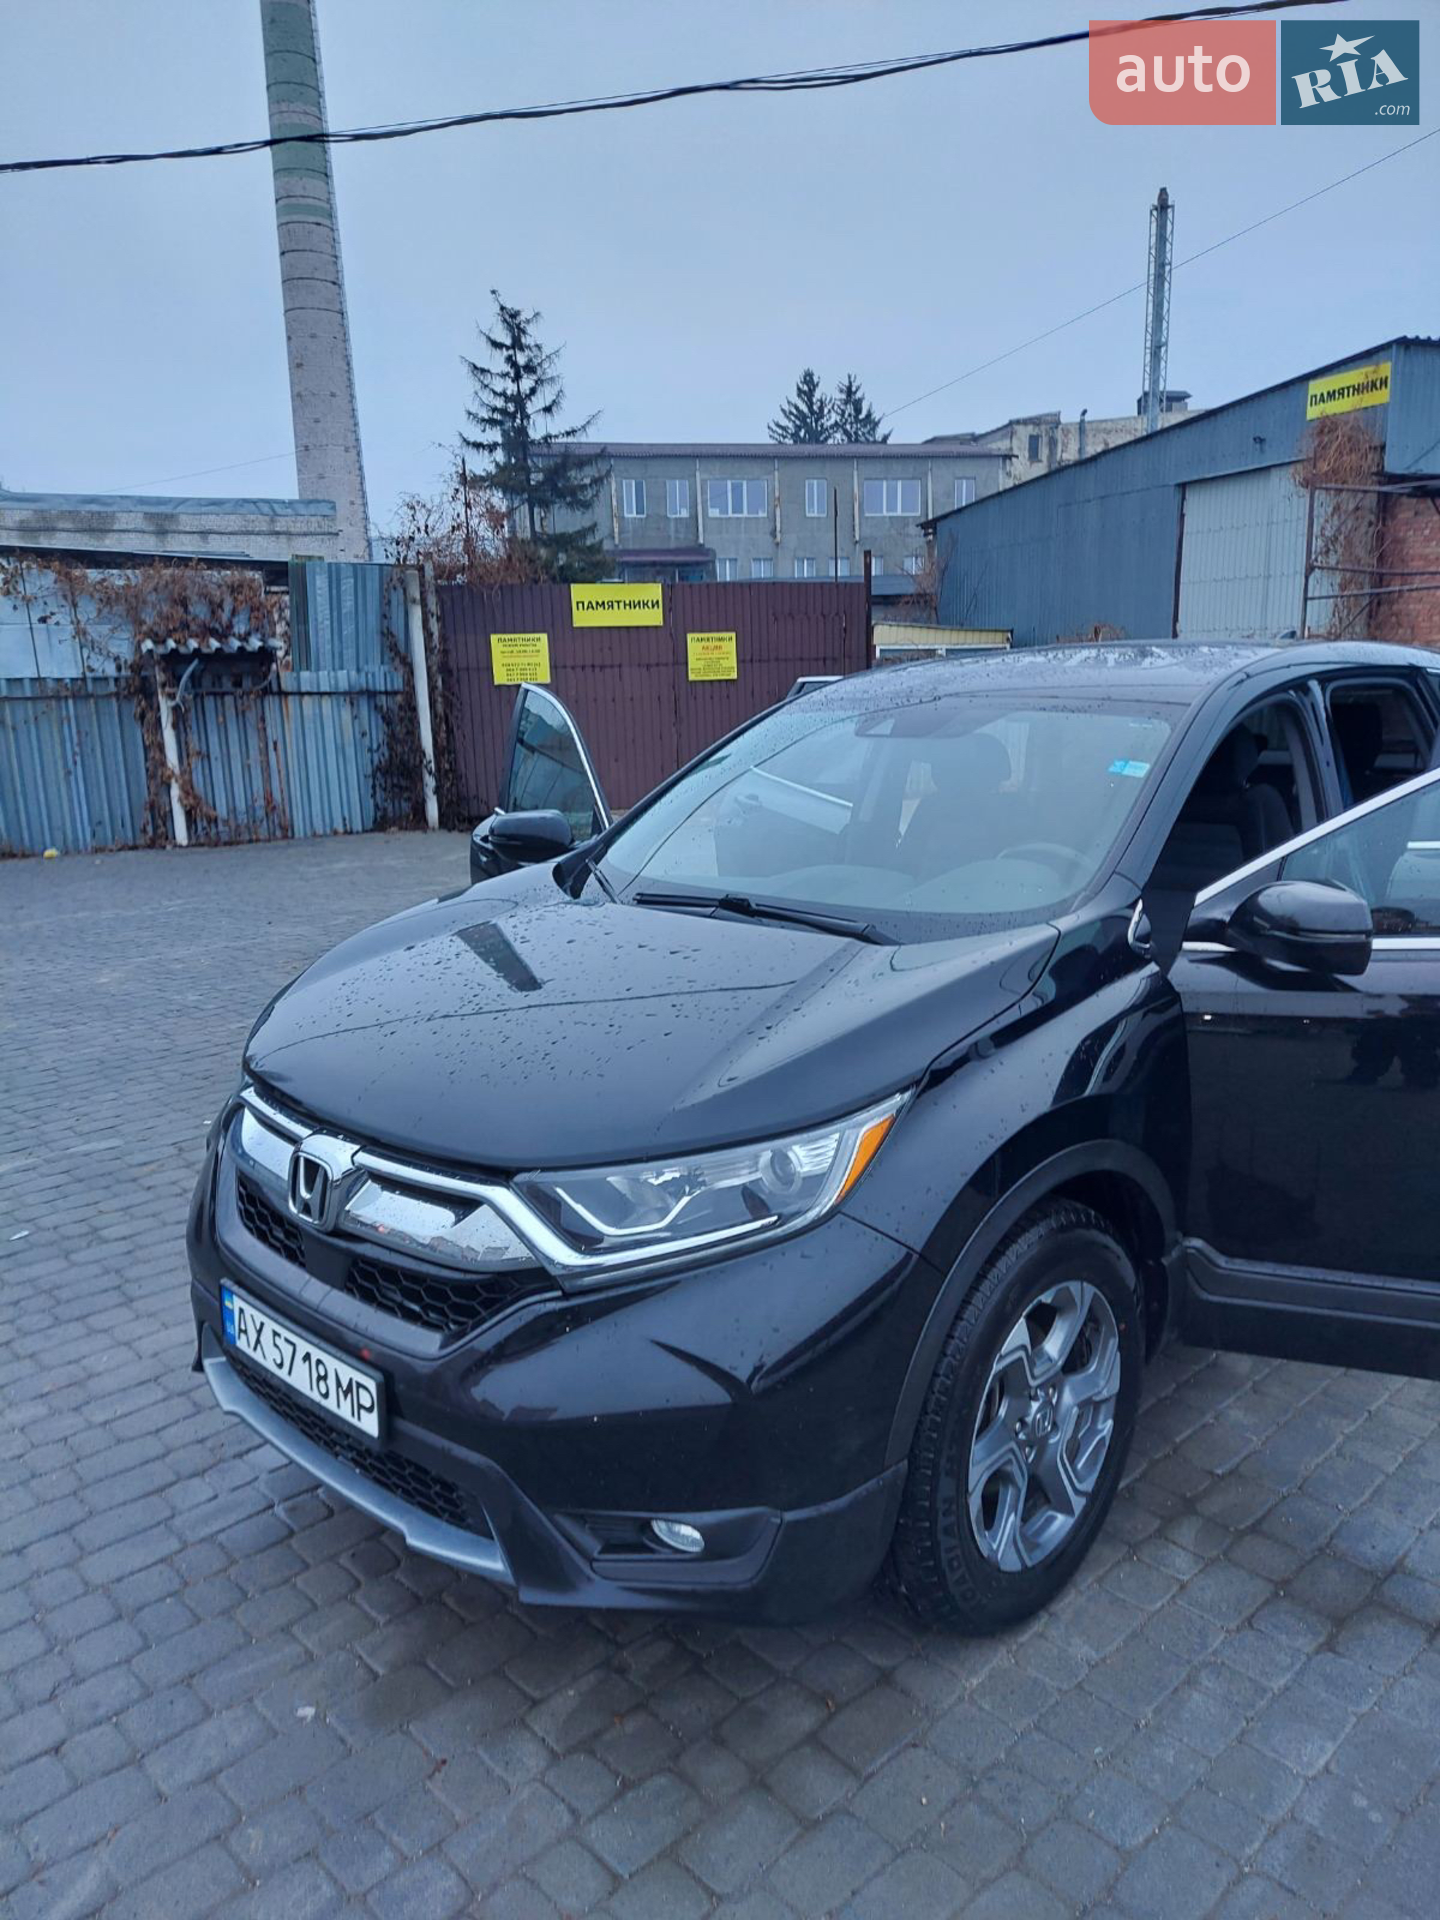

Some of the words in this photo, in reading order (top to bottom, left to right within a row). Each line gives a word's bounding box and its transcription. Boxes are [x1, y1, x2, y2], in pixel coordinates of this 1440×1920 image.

[1309, 376, 1389, 407] ПАМЯТНИКИ
[575, 599, 660, 612] ПАМЯТНИКИ
[497, 636, 541, 644] ПАМЯТНИКИ
[690, 635, 733, 643] ПАМЯТНИКИ
[237, 1306, 266, 1360] AX
[272, 1330, 330, 1399] 5718
[335, 1367, 375, 1422] MP
